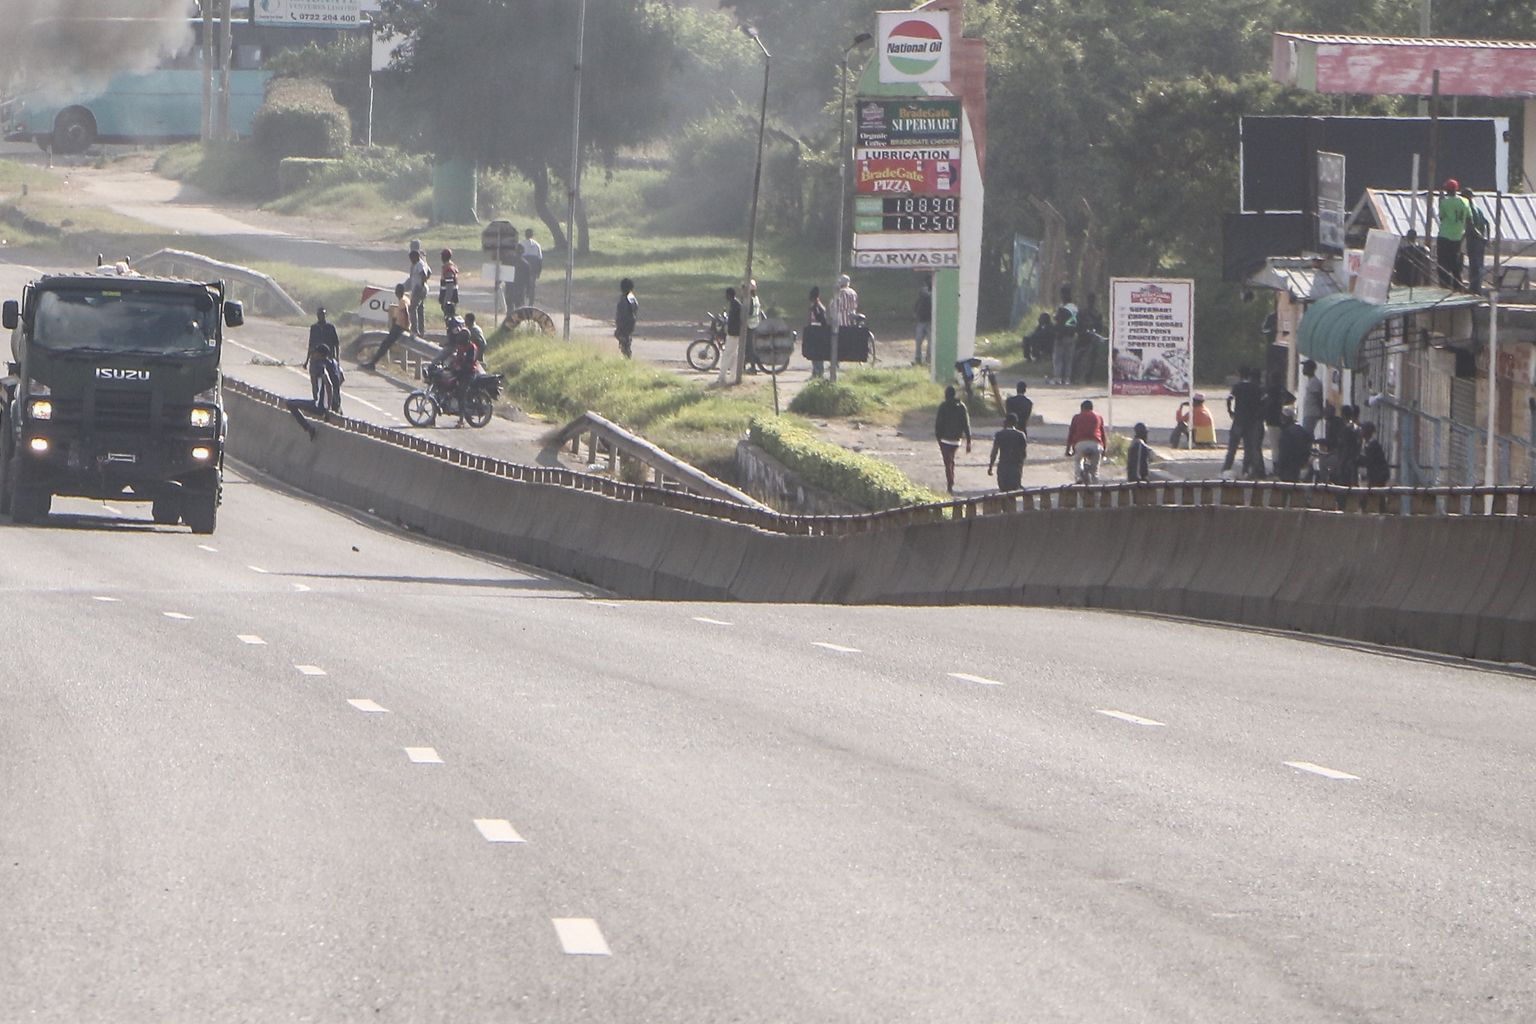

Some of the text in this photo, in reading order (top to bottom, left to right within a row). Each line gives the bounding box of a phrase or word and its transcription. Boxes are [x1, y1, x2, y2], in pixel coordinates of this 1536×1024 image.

[300, 13, 320, 21] 0722
[887, 42, 942, 53] National Oil
[892, 118, 958, 131] SUPERMART
[865, 150, 950, 159] LUBRICATION
[861, 168, 924, 182] BradeGate
[873, 179, 911, 192] PIZZA
[859, 253, 957, 264] CARWASH
[369, 299, 392, 313] OU
[95, 367, 150, 380] ISUZU
